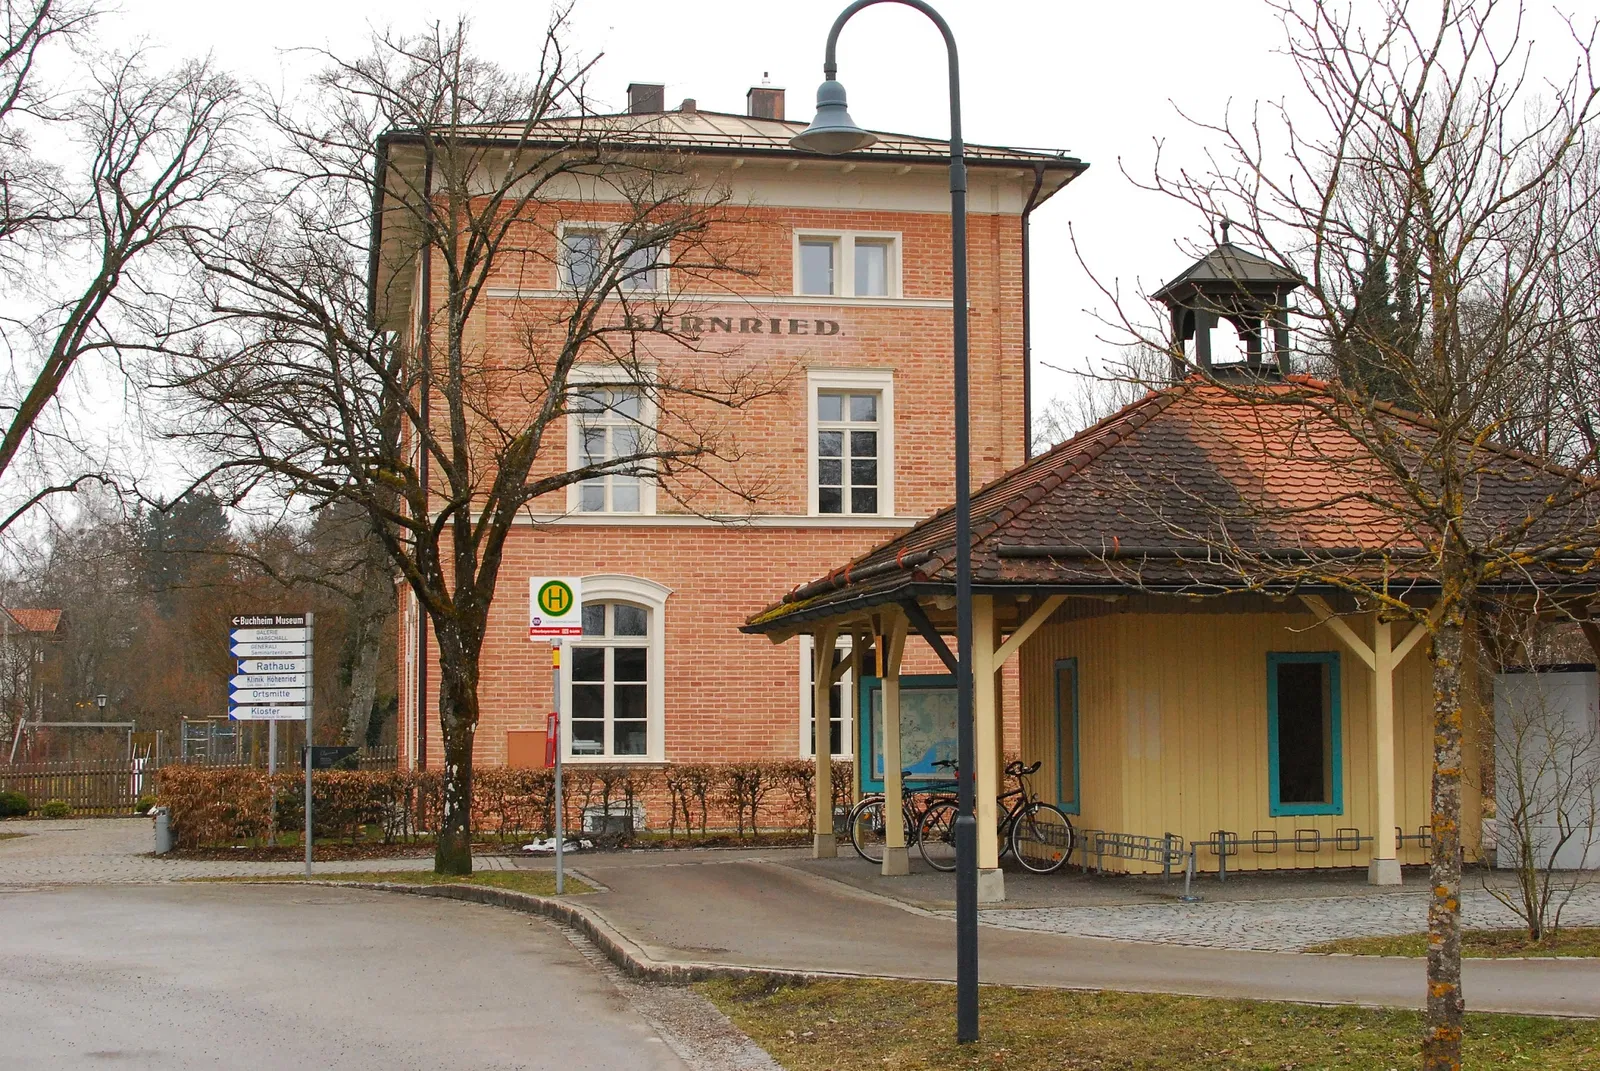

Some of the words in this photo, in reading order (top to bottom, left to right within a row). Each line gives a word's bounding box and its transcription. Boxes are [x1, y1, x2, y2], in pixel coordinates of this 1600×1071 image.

[549, 589, 562, 608] H
[240, 616, 273, 625] Buchheim
[275, 615, 304, 625] Museum
[257, 662, 295, 671] Rathaus
[252, 690, 291, 698] Ortsmitte
[251, 707, 280, 715] Kloster
